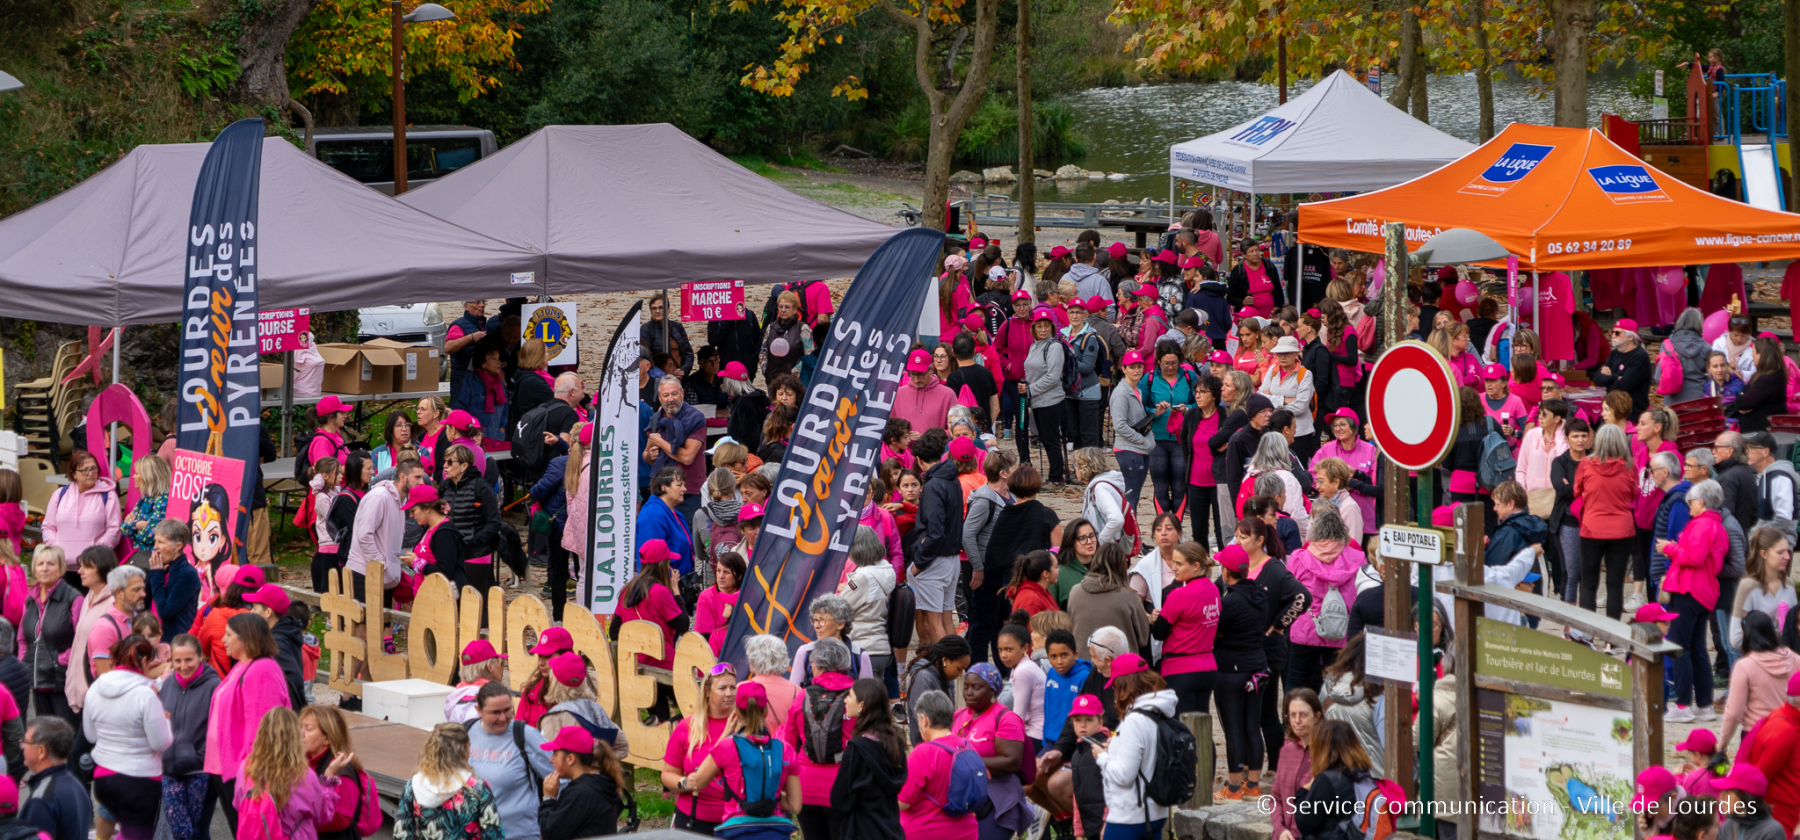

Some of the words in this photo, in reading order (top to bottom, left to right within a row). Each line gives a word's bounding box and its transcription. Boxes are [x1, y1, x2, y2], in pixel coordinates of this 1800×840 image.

[1494, 158, 1510, 168] LA
[1598, 176, 1614, 186] LA
[1347, 218, 1378, 236] Comité
[213, 222, 233, 282] des
[1548, 242, 1562, 254] 05
[1565, 242, 1579, 253] 62
[1582, 241, 1597, 252] 34
[1600, 240, 1614, 251] 20
[1617, 239, 1632, 250] 89
[693, 282, 731, 290] INSCRIPTIONS
[692, 291, 732, 306] MARCHE
[535, 308, 561, 319] LIONS
[702, 307, 713, 319] 10
[715, 306, 722, 319] €
[181, 224, 214, 432] LOURDES
[226, 220, 260, 428] PYRÉNÉES
[259, 319, 295, 336] OURSE
[541, 322, 555, 342] L
[261, 338, 273, 352] 10
[275, 337, 282, 350] €
[850, 328, 883, 390] des
[765, 317, 862, 540] LOURDES
[828, 333, 911, 553] PYRÉNÉES
[175, 456, 213, 476] OCTOBRE
[172, 471, 212, 504] ROSE
[594, 425, 615, 602] U.A.LOURDES
[1393, 531, 1406, 542] EAU
[1408, 533, 1436, 547] POTABLE
[1484, 641, 1510, 652] Bienvenue
[1543, 650, 1560, 659] Natura
[1561, 653, 1573, 661] 2000
[1485, 653, 1524, 670] Tourbière
[1525, 662, 1534, 672] et
[1536, 662, 1548, 674] lac
[1550, 664, 1560, 676] de
[1562, 666, 1596, 681] Lourdes
